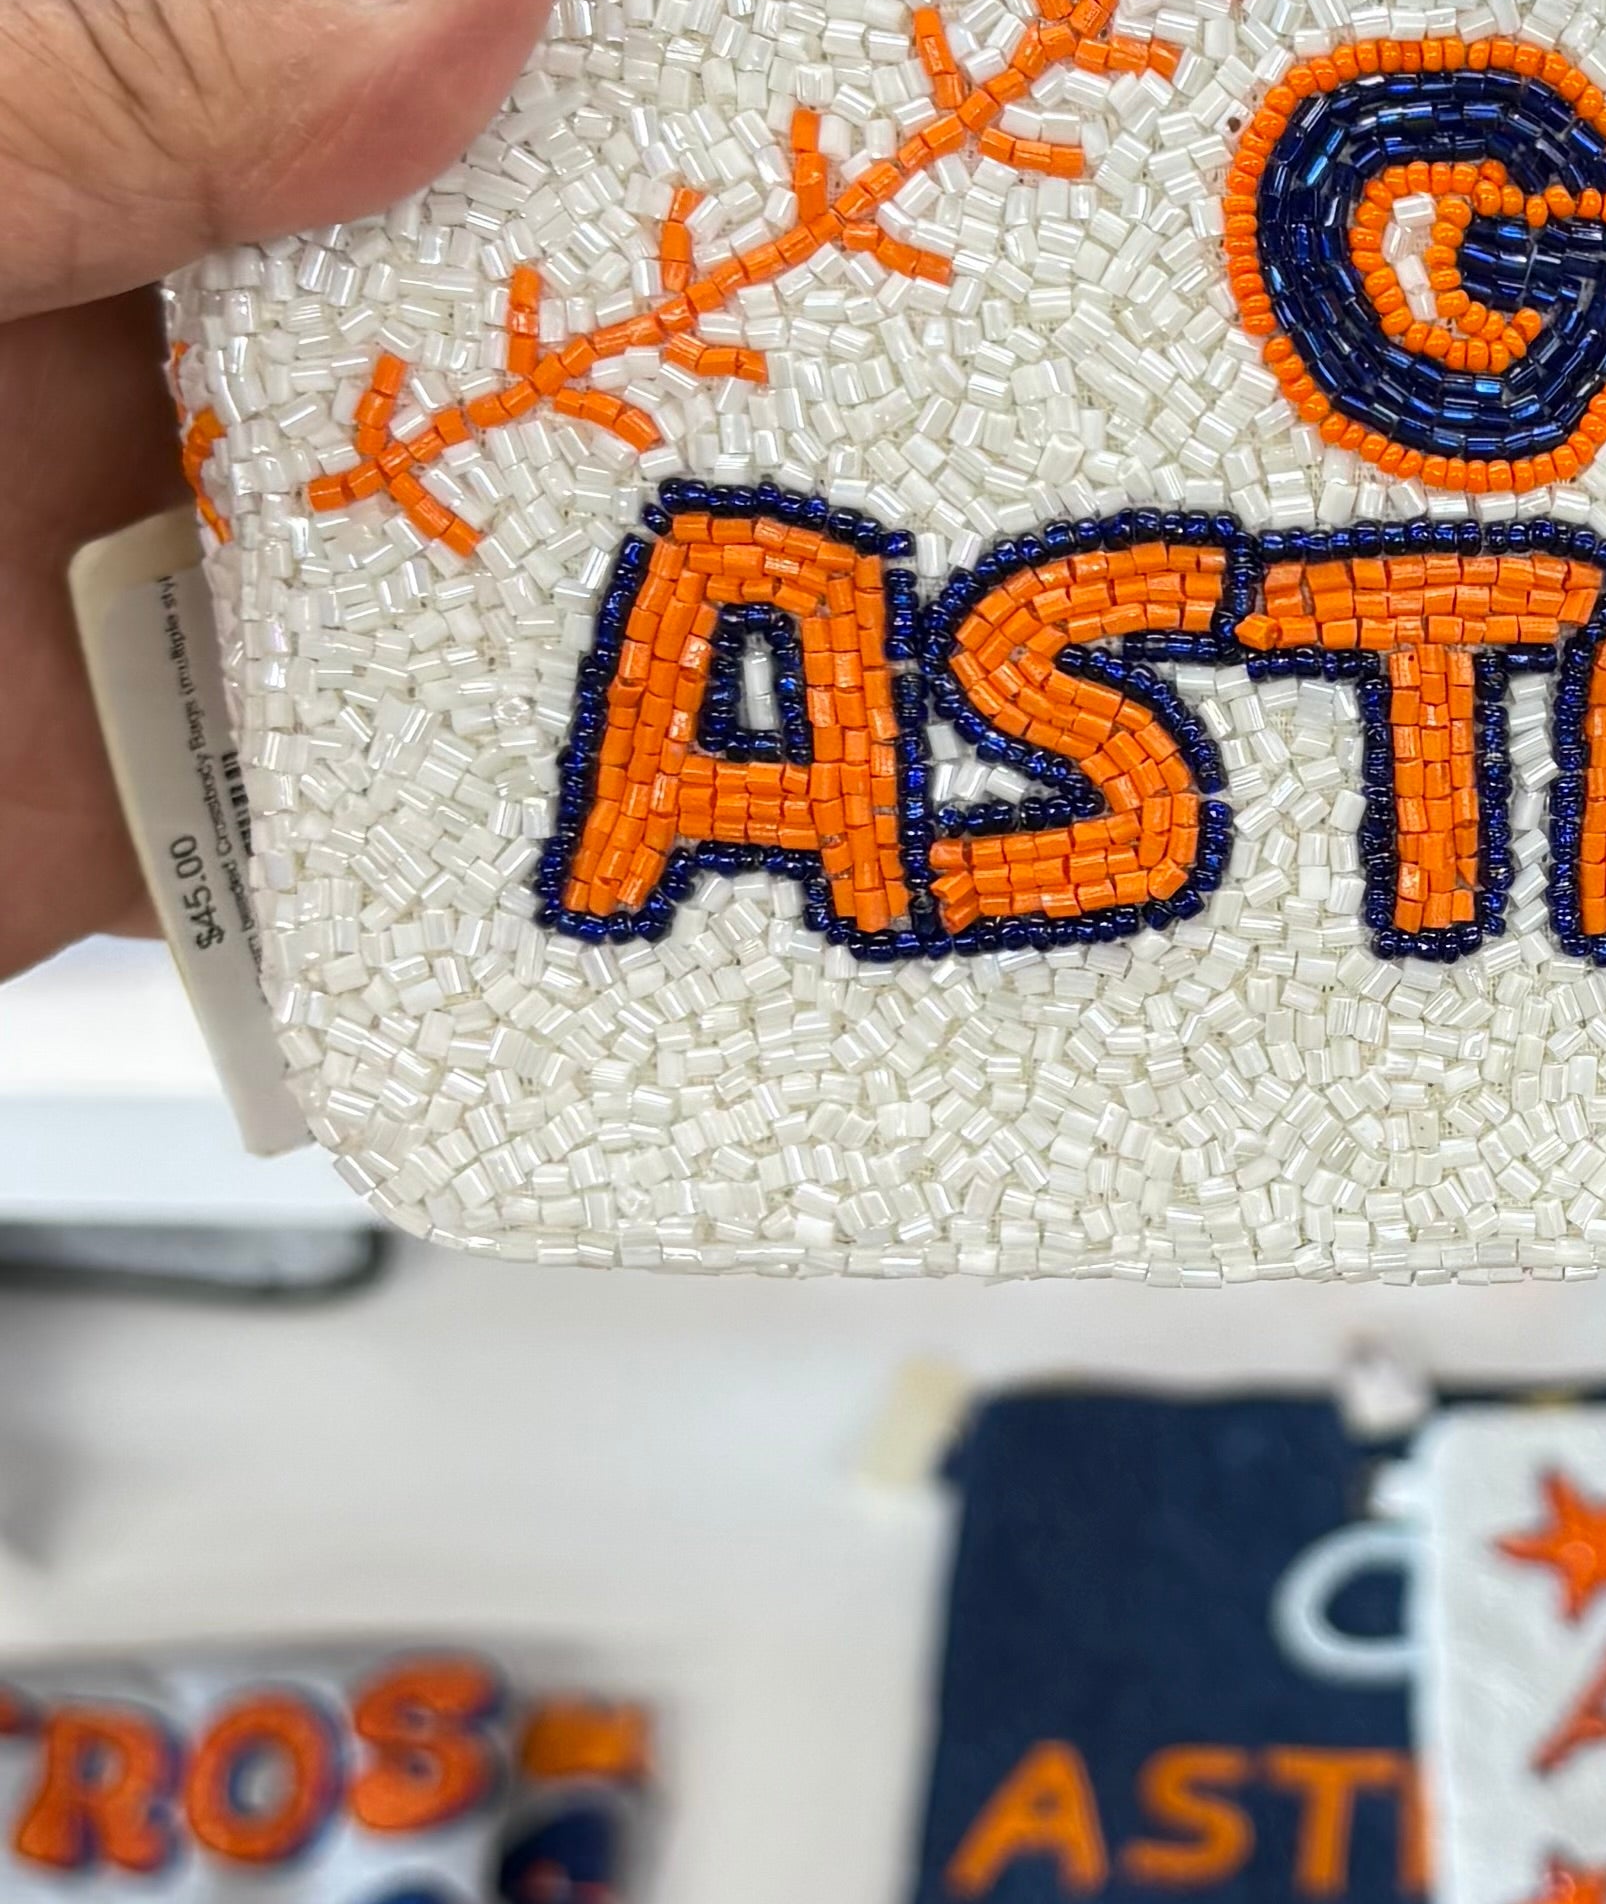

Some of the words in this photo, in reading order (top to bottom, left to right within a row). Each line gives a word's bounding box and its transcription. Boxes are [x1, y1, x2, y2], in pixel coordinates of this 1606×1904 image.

[164, 613, 197, 696] (multiple
[184, 698, 207, 753] Bags
[197, 754, 233, 857] Crossbody
[171, 834, 228, 952] $45.00
[0, 1645, 510, 1877] ROS
